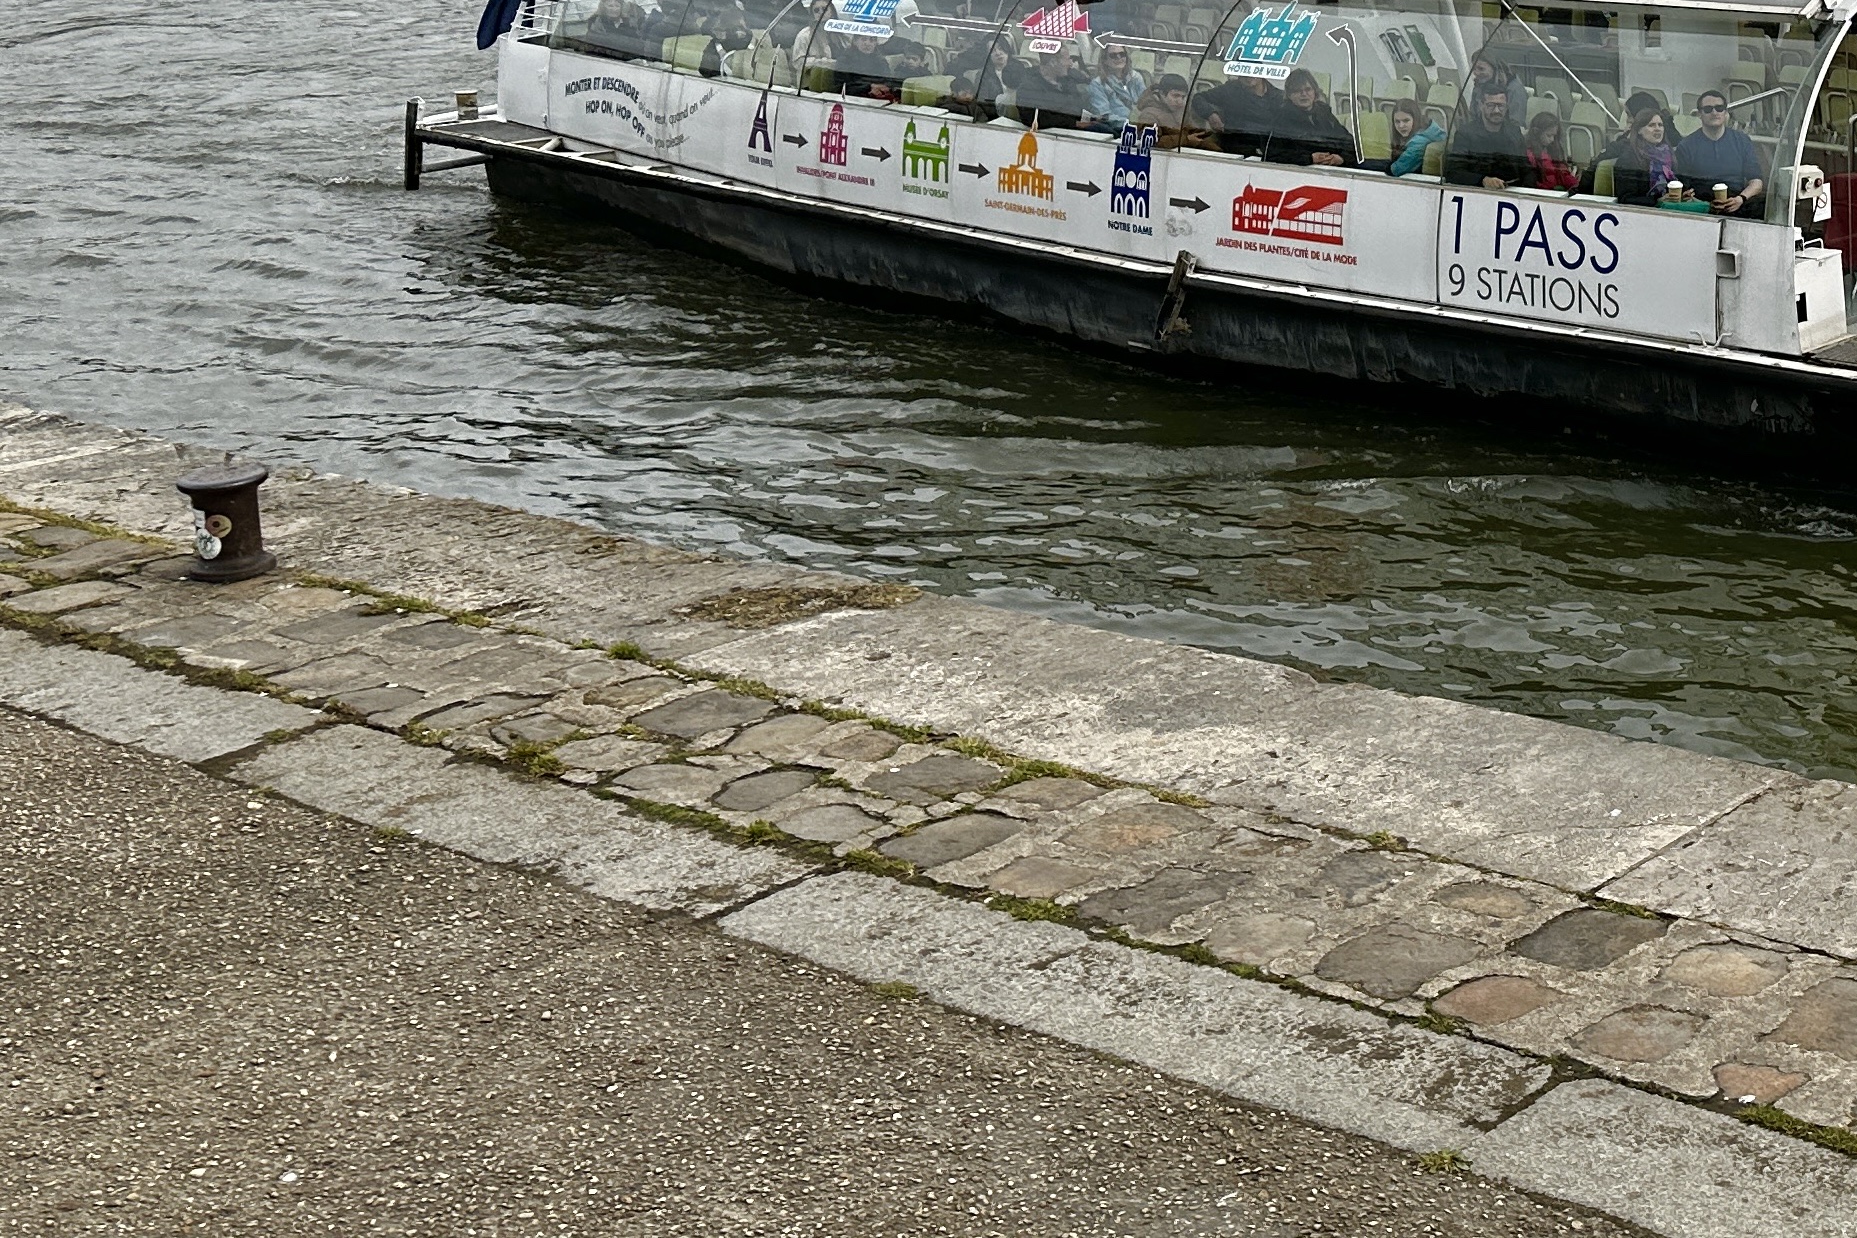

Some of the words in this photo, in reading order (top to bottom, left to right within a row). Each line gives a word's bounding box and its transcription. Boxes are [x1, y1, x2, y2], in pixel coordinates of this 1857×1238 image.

[1253, 66, 1264, 75] DE
[1266, 67, 1287, 78] VILLE
[565, 77, 592, 97] MONTER
[593, 76, 601, 90] ET
[601, 77, 640, 104] DESCENDRE
[586, 100, 600, 114] HOP
[600, 100, 614, 116] ON,
[615, 102, 632, 121] HOP
[631, 116, 646, 138] OFF
[922, 186, 949, 199] D'ORSAY
[1107, 220, 1131, 232] NOTRE
[1132, 223, 1153, 236] DAME
[1452, 196, 1464, 254] 1
[1494, 200, 1620, 274] PASS
[1216, 236, 1242, 250] JARDIN
[1243, 241, 1257, 252] DES
[1310, 250, 1321, 260] DE
[1321, 252, 1333, 263] LA
[1333, 254, 1358, 266] MODE
[1449, 263, 1465, 296] 9
[1476, 266, 1620, 319] STATIONS
